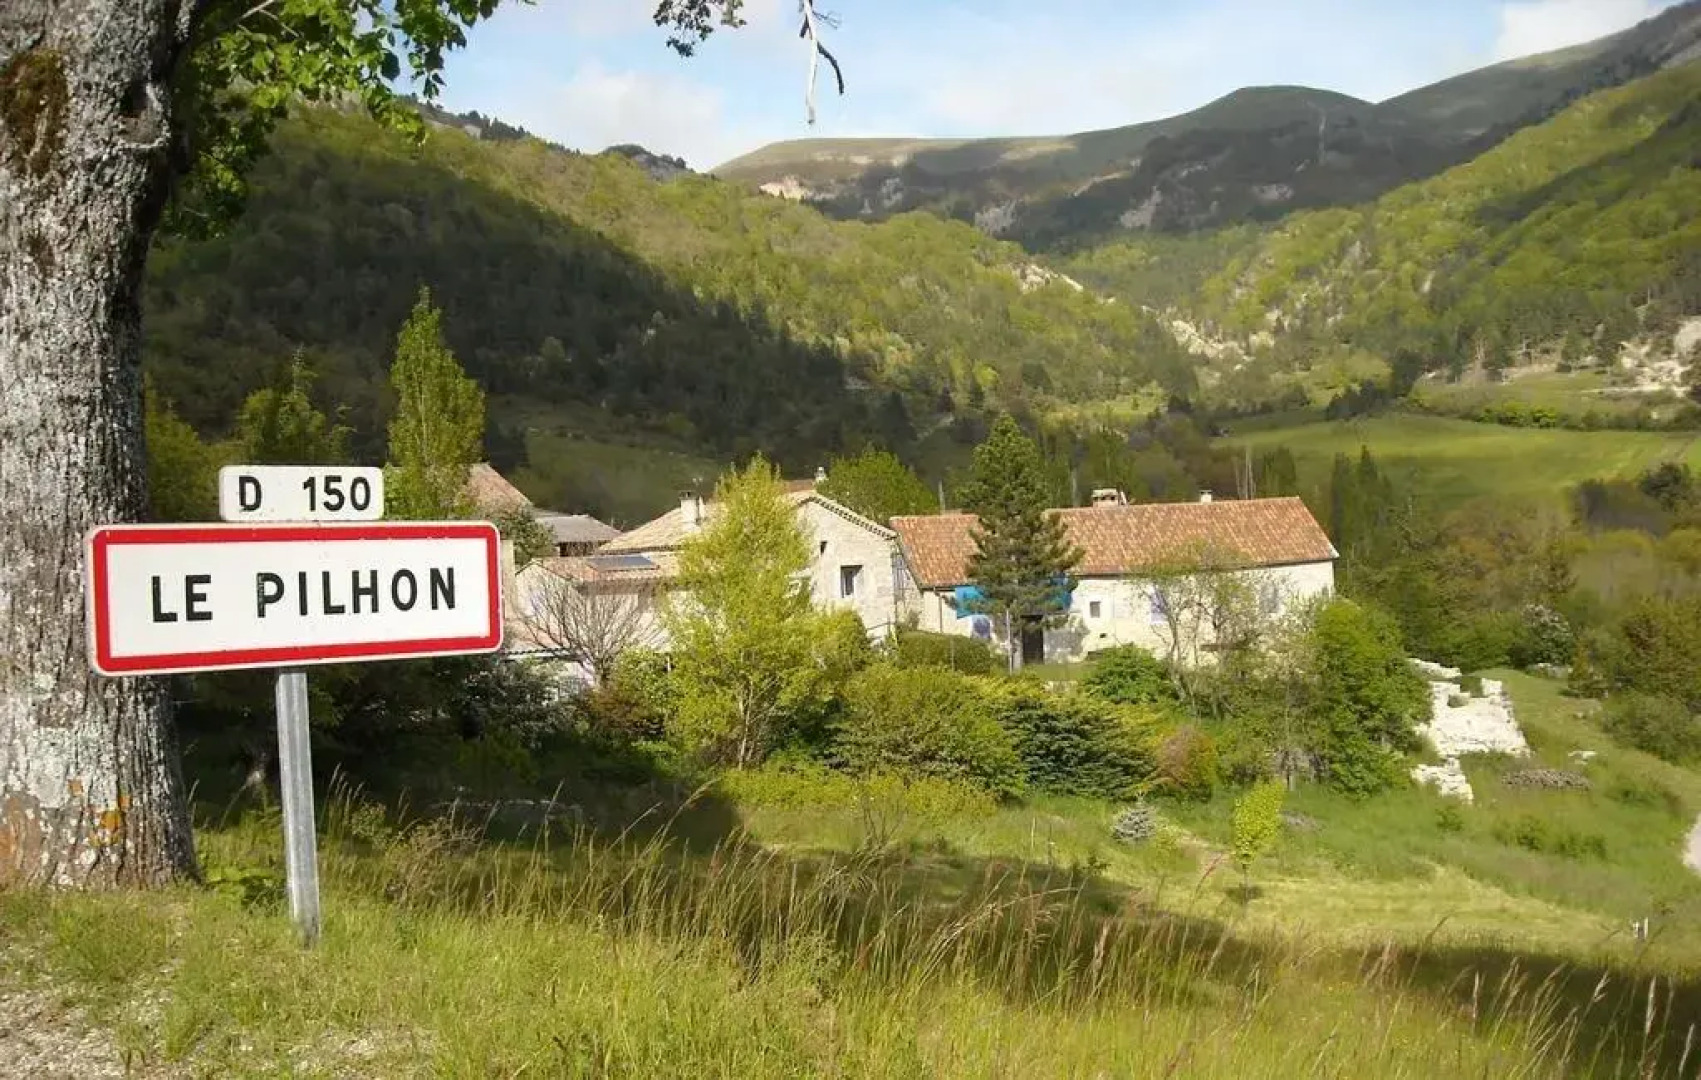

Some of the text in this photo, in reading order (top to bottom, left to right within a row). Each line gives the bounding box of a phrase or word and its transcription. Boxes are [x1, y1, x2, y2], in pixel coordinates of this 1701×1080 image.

[238, 475, 371, 512] D 150
[151, 567, 456, 624] LE PILHON
